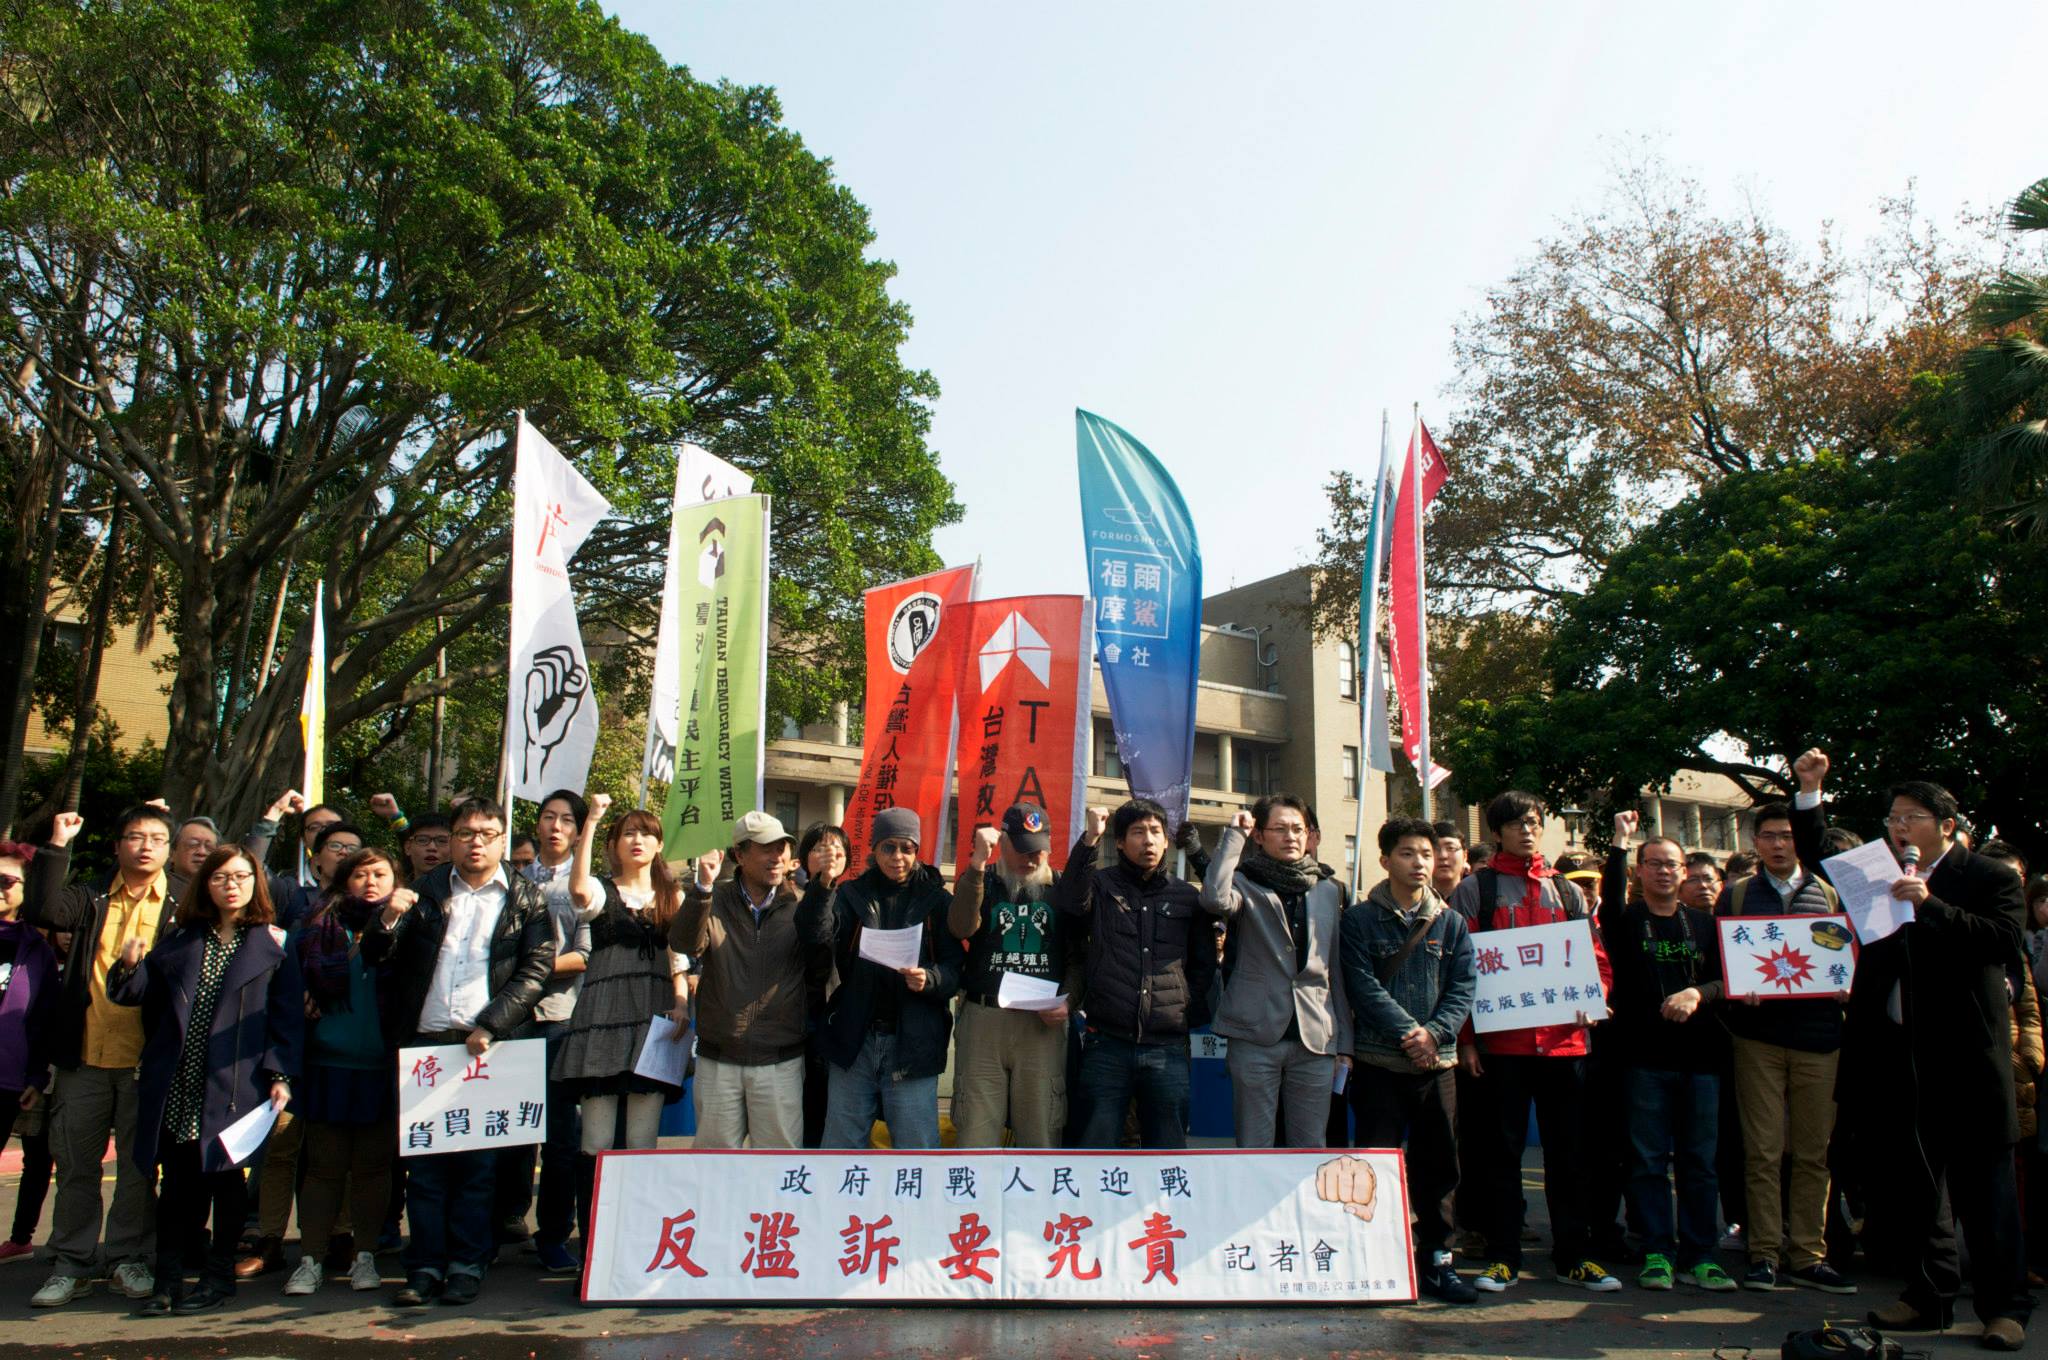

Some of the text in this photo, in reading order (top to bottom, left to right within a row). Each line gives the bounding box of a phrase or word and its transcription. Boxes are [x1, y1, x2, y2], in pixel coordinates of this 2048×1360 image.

[1101, 559, 1160, 592] 福爾
[1100, 595, 1159, 628] 摩鯊
[1104, 643, 1150, 667] 會社
[716, 596, 734, 821] TAIWAN DEMOCRACY WATCH
[1732, 922, 1785, 946] 我要
[1825, 963, 1849, 986] 警
[1475, 982, 1602, 1014] 院版監督條例
[411, 1055, 490, 1088] 停止
[408, 1101, 544, 1149] 貨貿談判
[780, 1164, 1191, 1199] 政府開戰 人民迎戰
[645, 1209, 1188, 1286] 反濫訴要究責
[1224, 1239, 1339, 1273] 記者會
